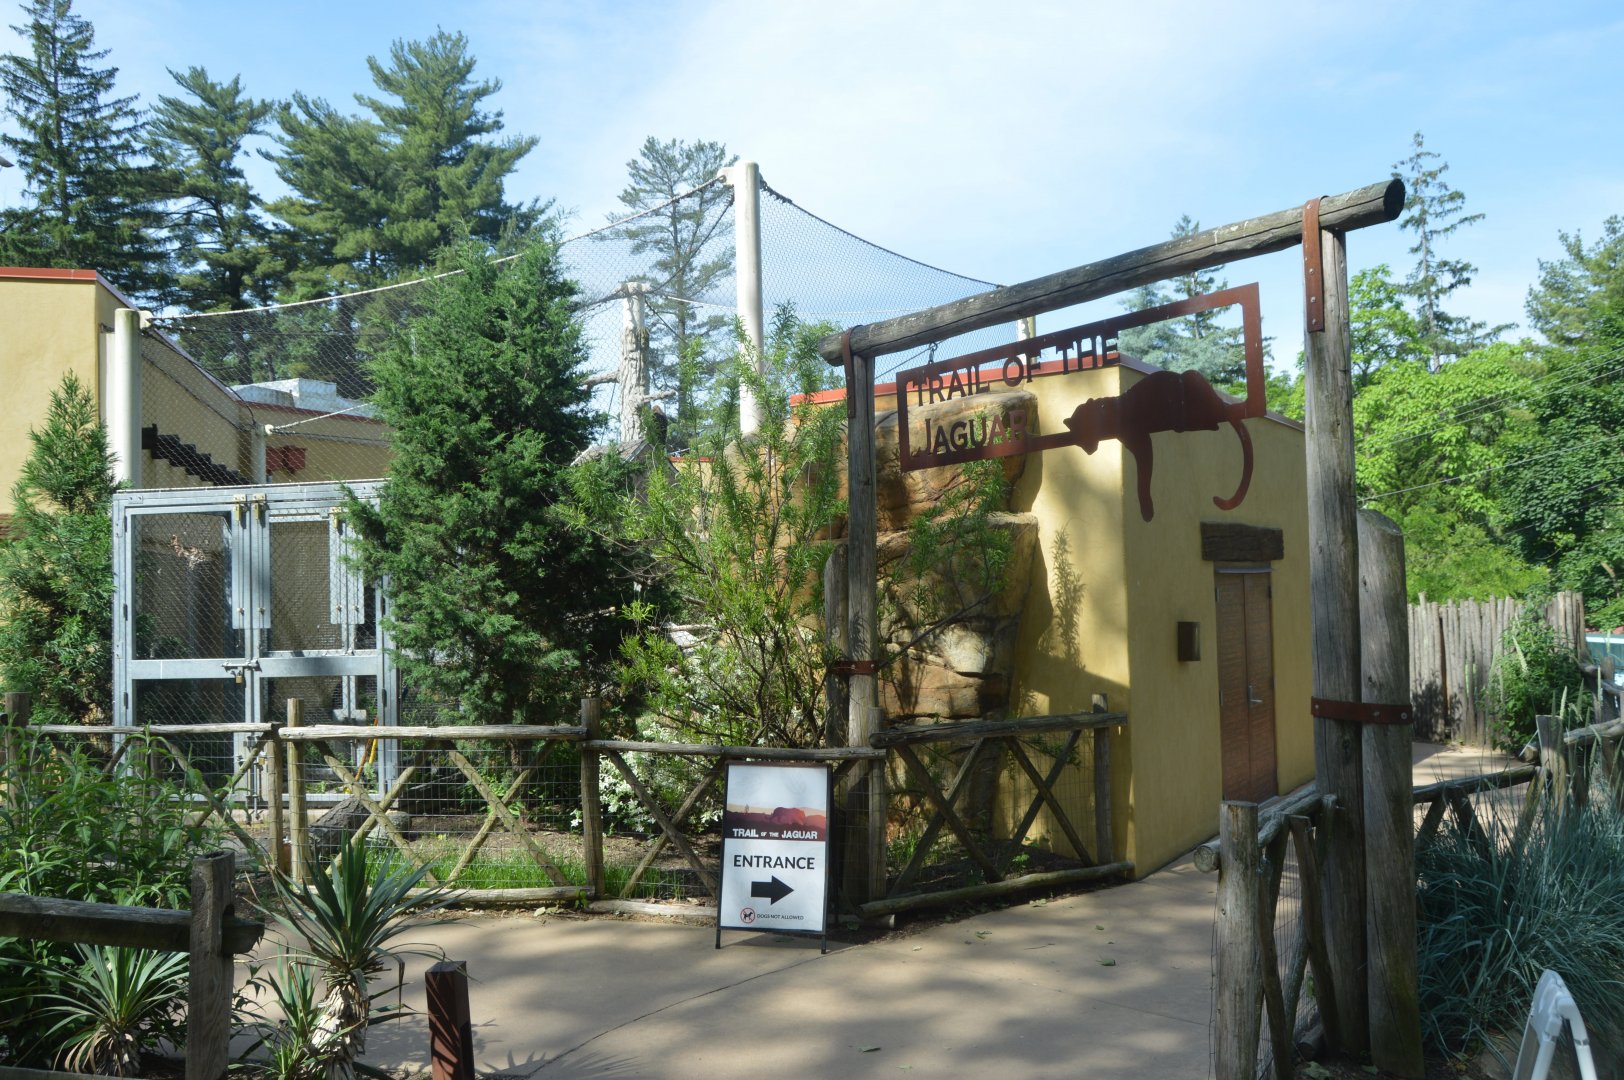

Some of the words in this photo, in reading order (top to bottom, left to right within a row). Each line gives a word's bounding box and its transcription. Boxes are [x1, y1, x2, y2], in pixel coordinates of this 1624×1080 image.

[912, 364, 990, 407] TRAIL
[1002, 351, 1042, 387] OF
[1055, 331, 1121, 375] THE
[909, 410, 1027, 457] JAGUAR
[732, 828, 759, 838] TRAIL
[781, 830, 818, 840] JAGUAR
[733, 854, 815, 870] ENTRANCE
